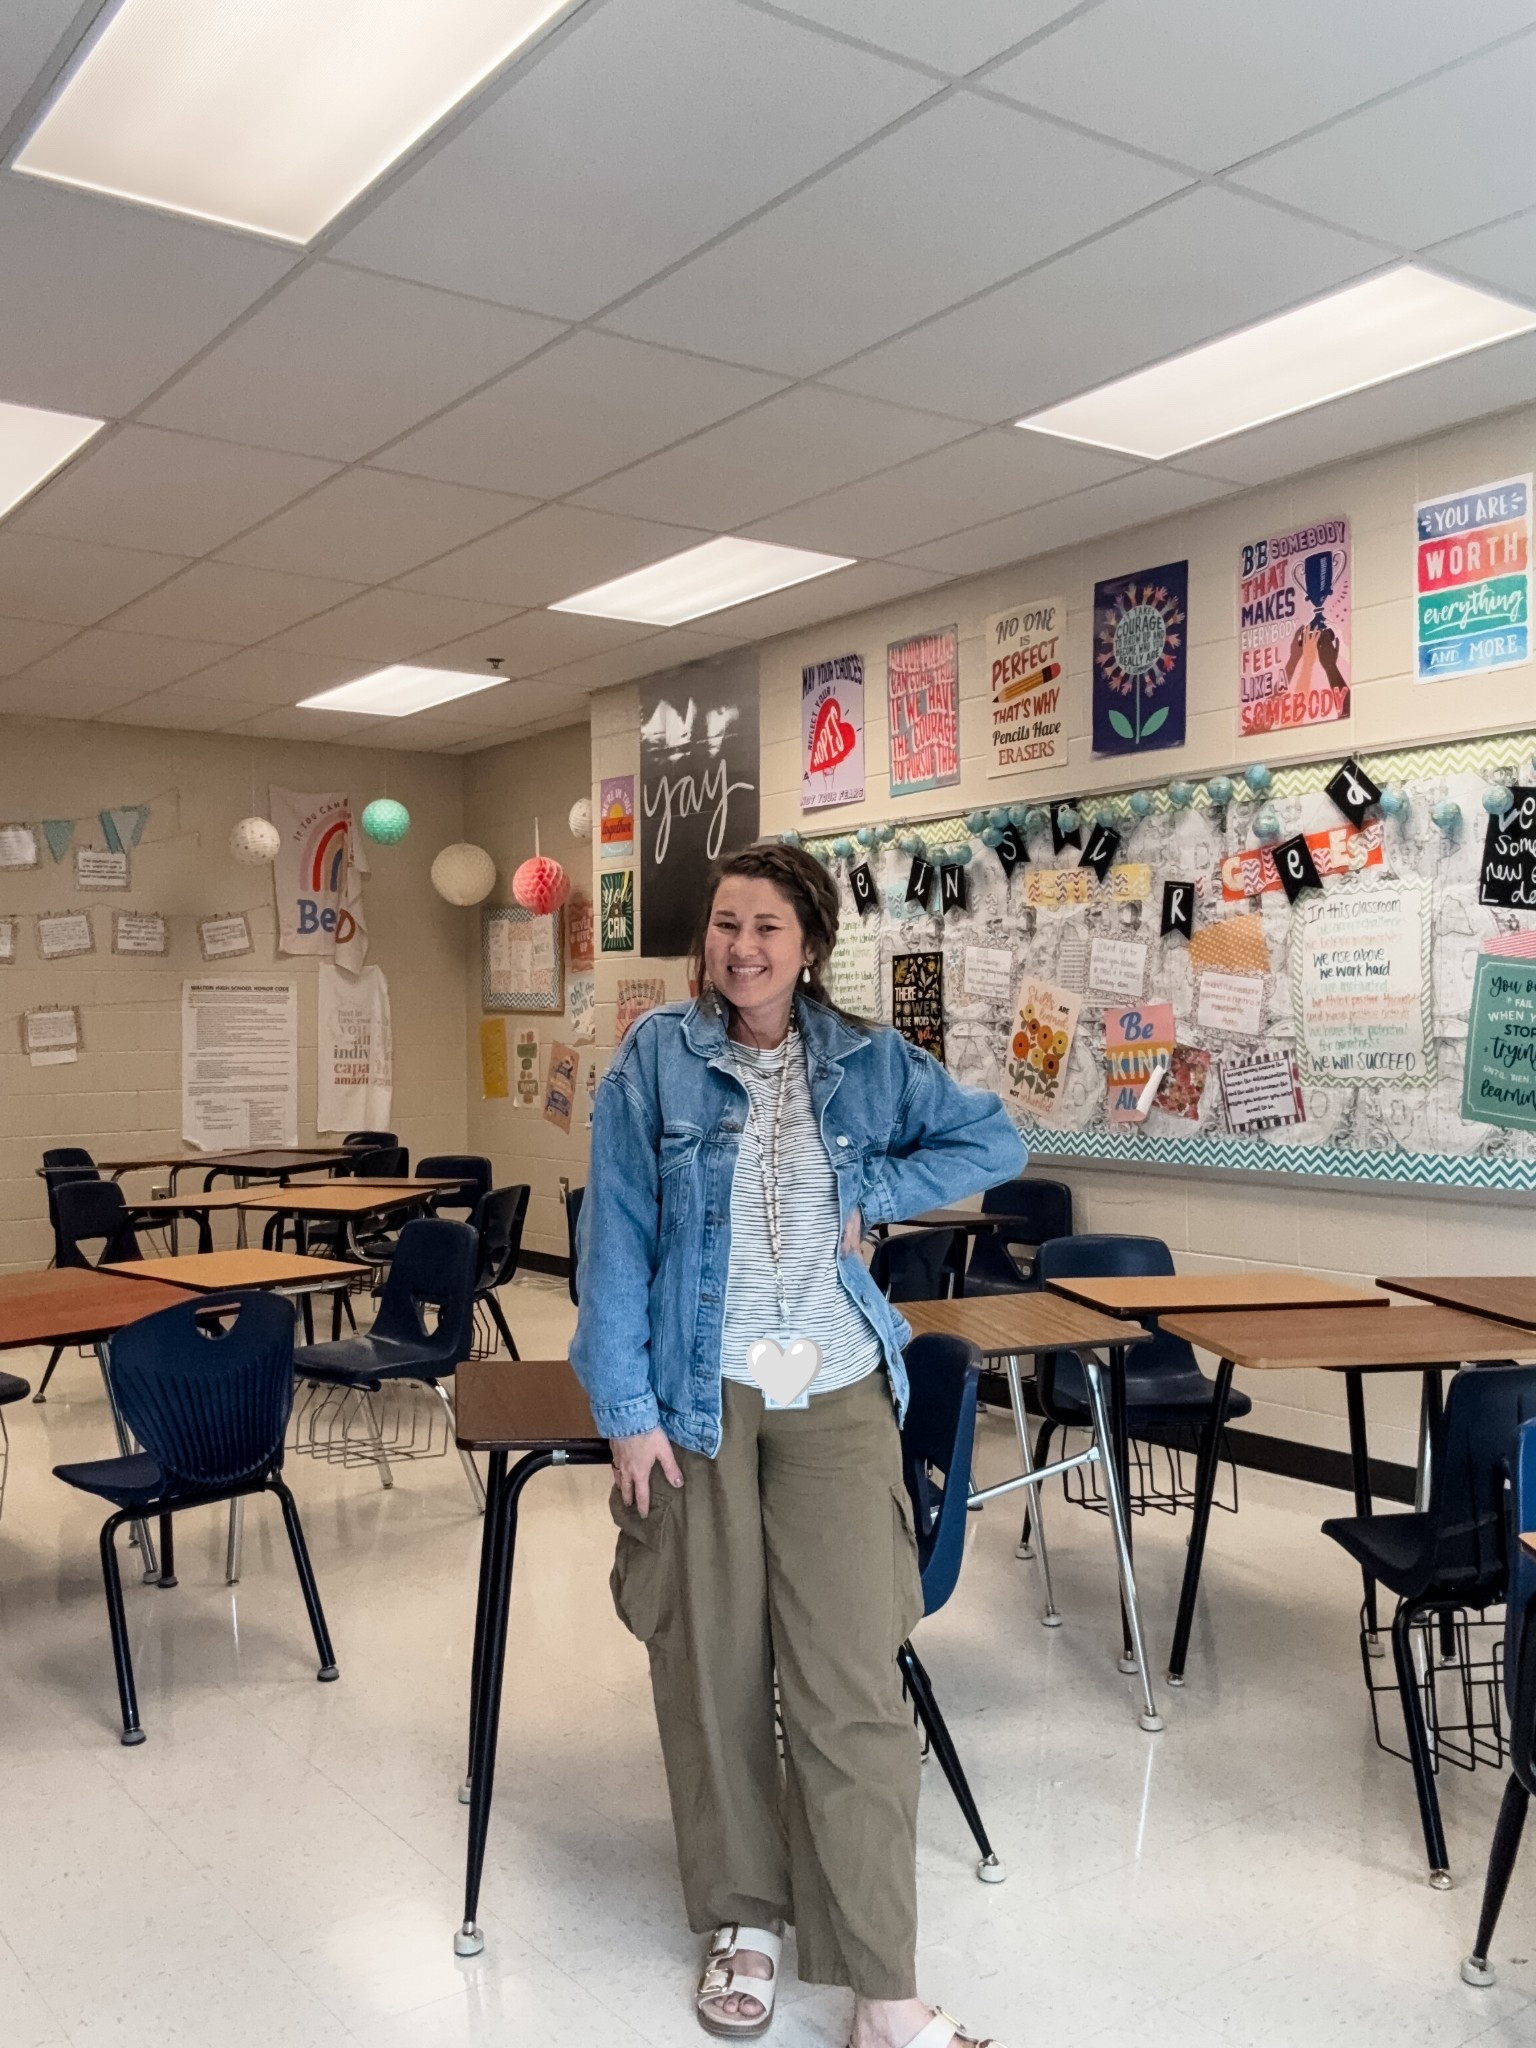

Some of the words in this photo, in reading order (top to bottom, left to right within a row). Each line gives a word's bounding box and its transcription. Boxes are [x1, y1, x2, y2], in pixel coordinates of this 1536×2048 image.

[1435, 504, 1469, 531] YOU
[1476, 495, 1509, 522] ARE
[1242, 540, 1268, 578] BE
[1269, 521, 1345, 559] SOMEBODY
[1426, 532, 1518, 580] WORTH
[1241, 560, 1288, 604] THAT
[1241, 587, 1295, 627] MAKES
[1424, 584, 1524, 630] everything
[996, 617, 1019, 644] NO
[1023, 607, 1056, 632] ONE
[1019, 635, 1031, 647] IS
[1116, 615, 1162, 639] COURAGE
[1241, 619, 1298, 650] EVERYBODY
[992, 636, 1060, 691] PERFECT
[1242, 647, 1282, 674] FEEL
[1430, 651, 1459, 665] AND
[1469, 634, 1518, 661] MORE
[926, 683, 956, 715] HAVE
[1241, 672, 1272, 702] LIKE
[1278, 669, 1288, 691] A
[993, 698, 1031, 725] THAT'S
[1033, 686, 1060, 717] WHY
[1241, 687, 1349, 732] SOMEBODY
[808, 712, 818, 751] REFLECT
[813, 705, 844, 767] HOPES
[992, 725, 1030, 746] Pencils
[1032, 721, 1061, 738] Have
[998, 740, 1056, 766] ERASERS
[644, 759, 754, 865] yay
[1486, 862, 1522, 882] new
[1308, 904, 1324, 924] In
[1327, 902, 1350, 919] this
[1352, 899, 1401, 919] classroom
[608, 917, 627, 939] CAN
[1332, 950, 1350, 963] rise
[1353, 948, 1384, 962] above
[1336, 964, 1363, 977] work
[1365, 960, 1390, 977] hard
[895, 986, 916, 1001] THERE
[895, 1001, 938, 1016] POWER
[1515, 998, 1534, 1009] FAIL
[1058, 1005, 1070, 1015] ARE
[1488, 1010, 1524, 1023] WHEN
[1119, 1012, 1154, 1041] Be
[1111, 1048, 1170, 1081] KIND
[1332, 1053, 1353, 1071] will
[1356, 1051, 1416, 1072] SUCCEED
